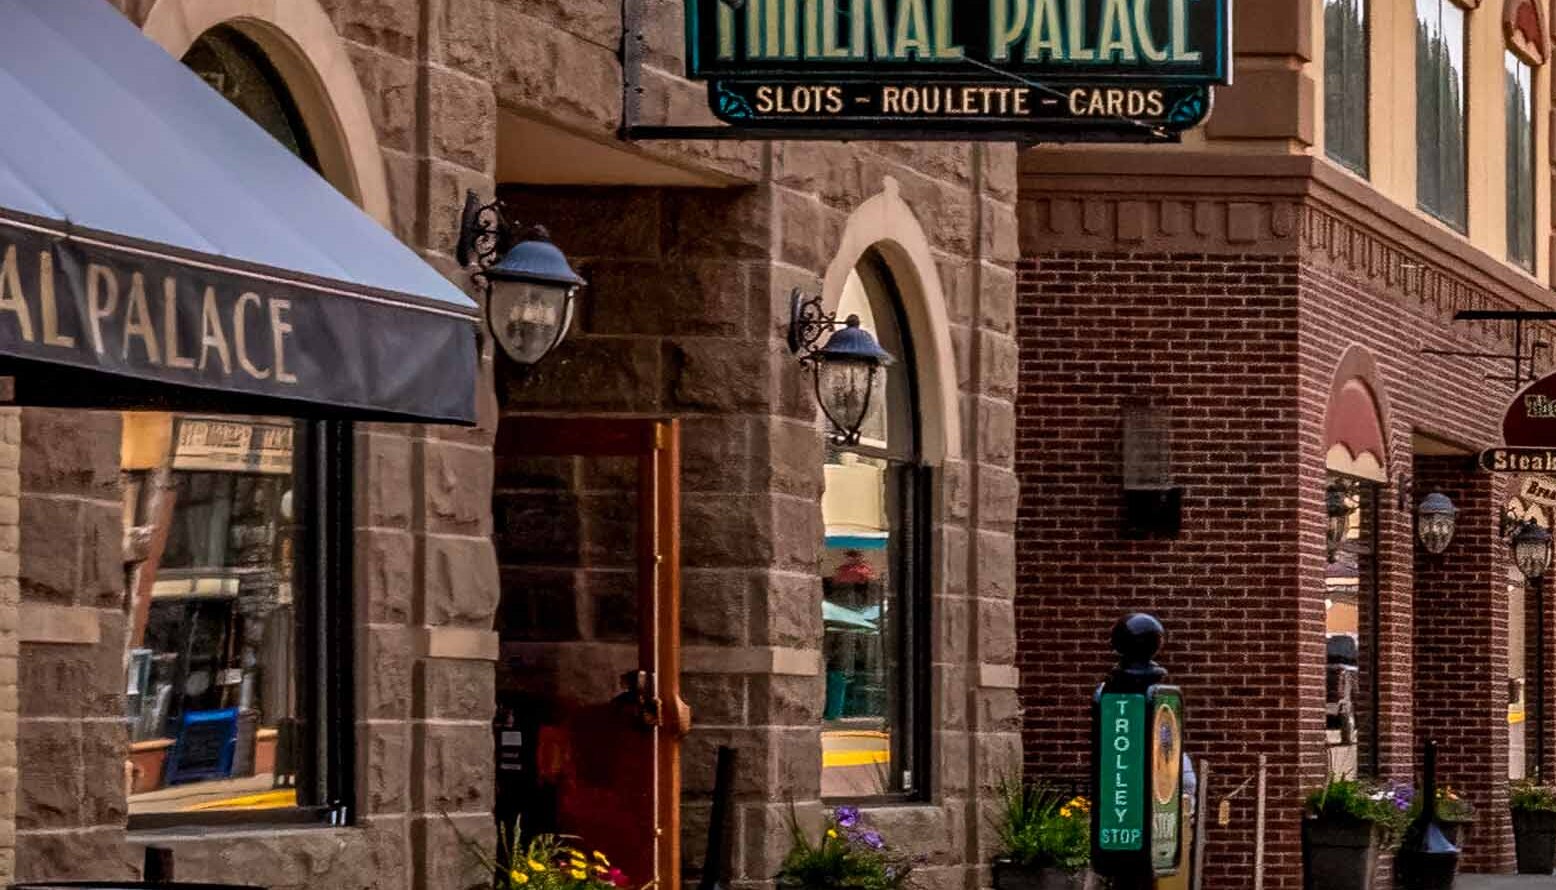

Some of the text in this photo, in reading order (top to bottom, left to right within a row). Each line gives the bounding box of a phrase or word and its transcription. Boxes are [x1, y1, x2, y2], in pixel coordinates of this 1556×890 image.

[755, 85, 1164, 117] SLOTS ROULETTE CARDS
[86, 262, 298, 385] PALACE
[1113, 700, 1130, 824] TROLLEY
[1101, 828, 1142, 844] STOP
